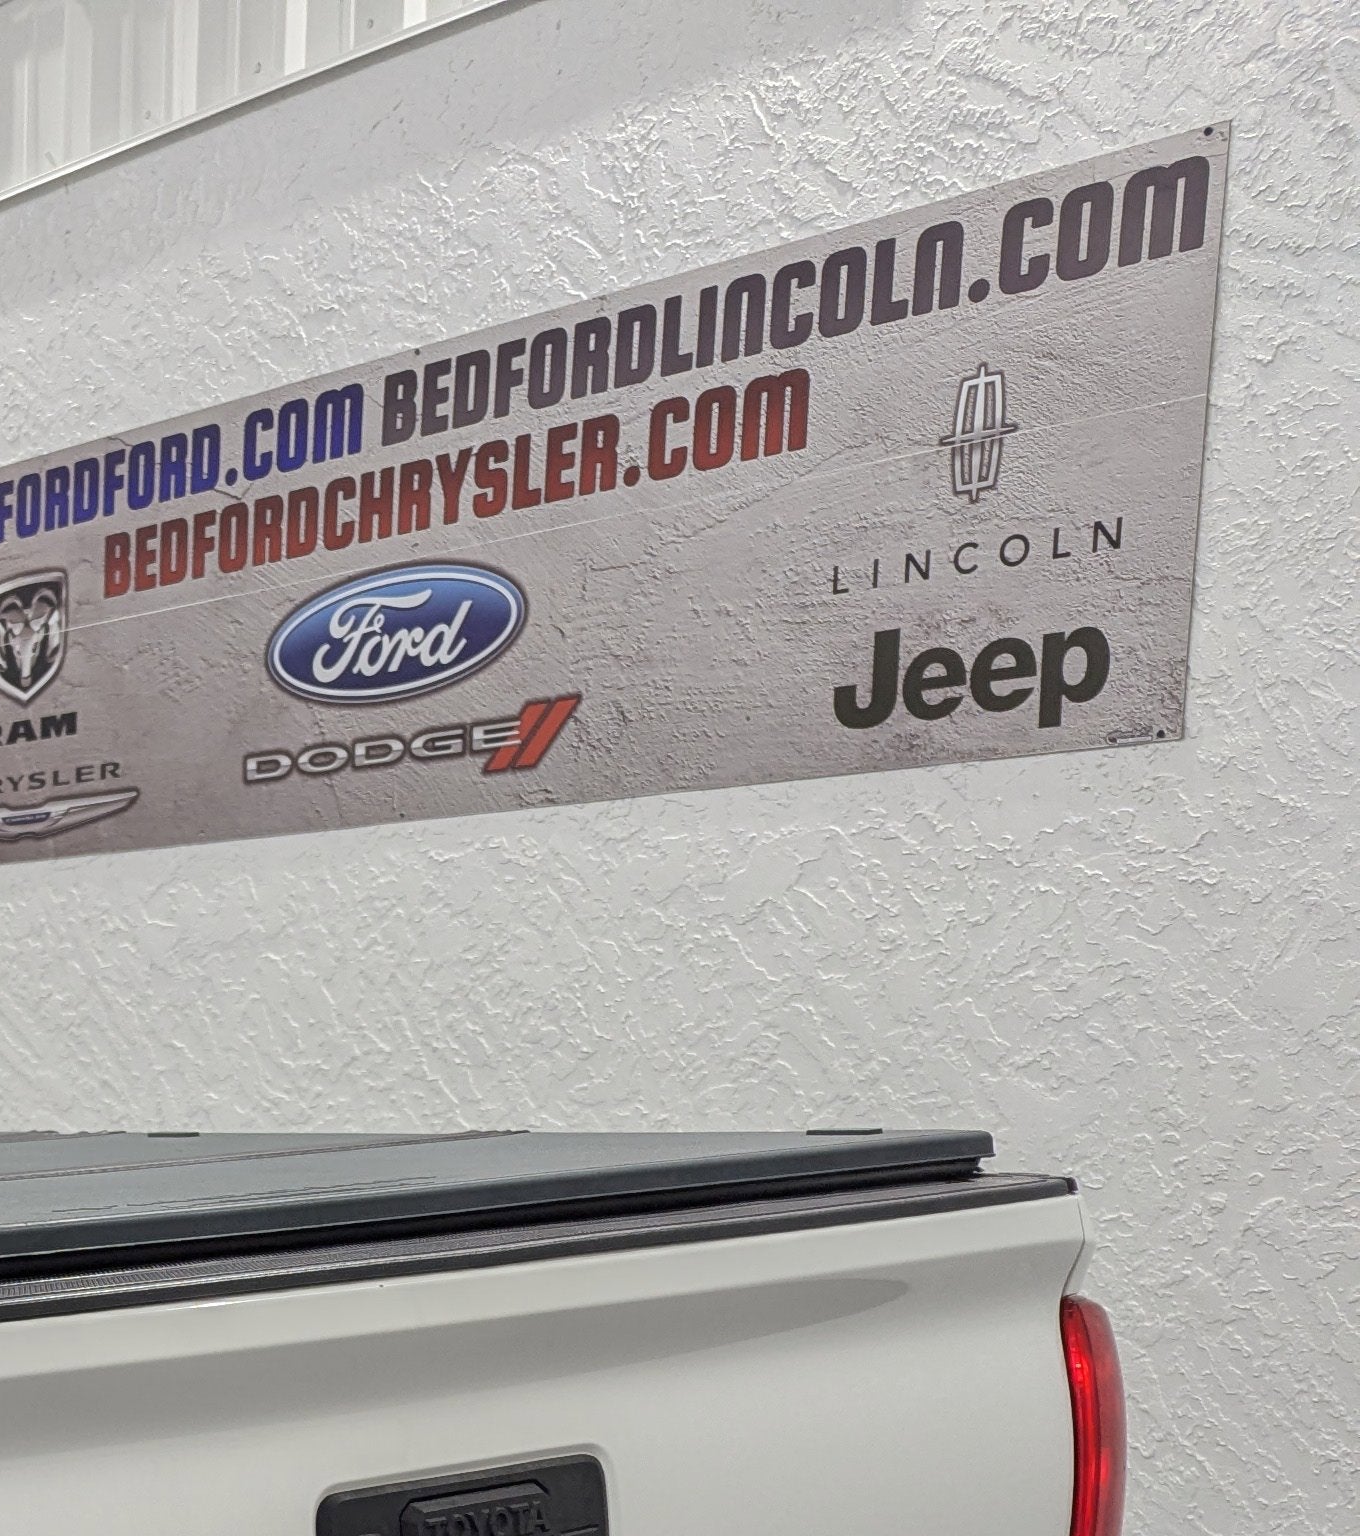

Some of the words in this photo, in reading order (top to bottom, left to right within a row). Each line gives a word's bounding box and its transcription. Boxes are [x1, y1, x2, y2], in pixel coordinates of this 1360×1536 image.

[832, 516, 1123, 595] LINCOLN
[312, 589, 472, 683] Ford
[833, 626, 1111, 730] Jeep
[245, 719, 523, 782] DODGE
